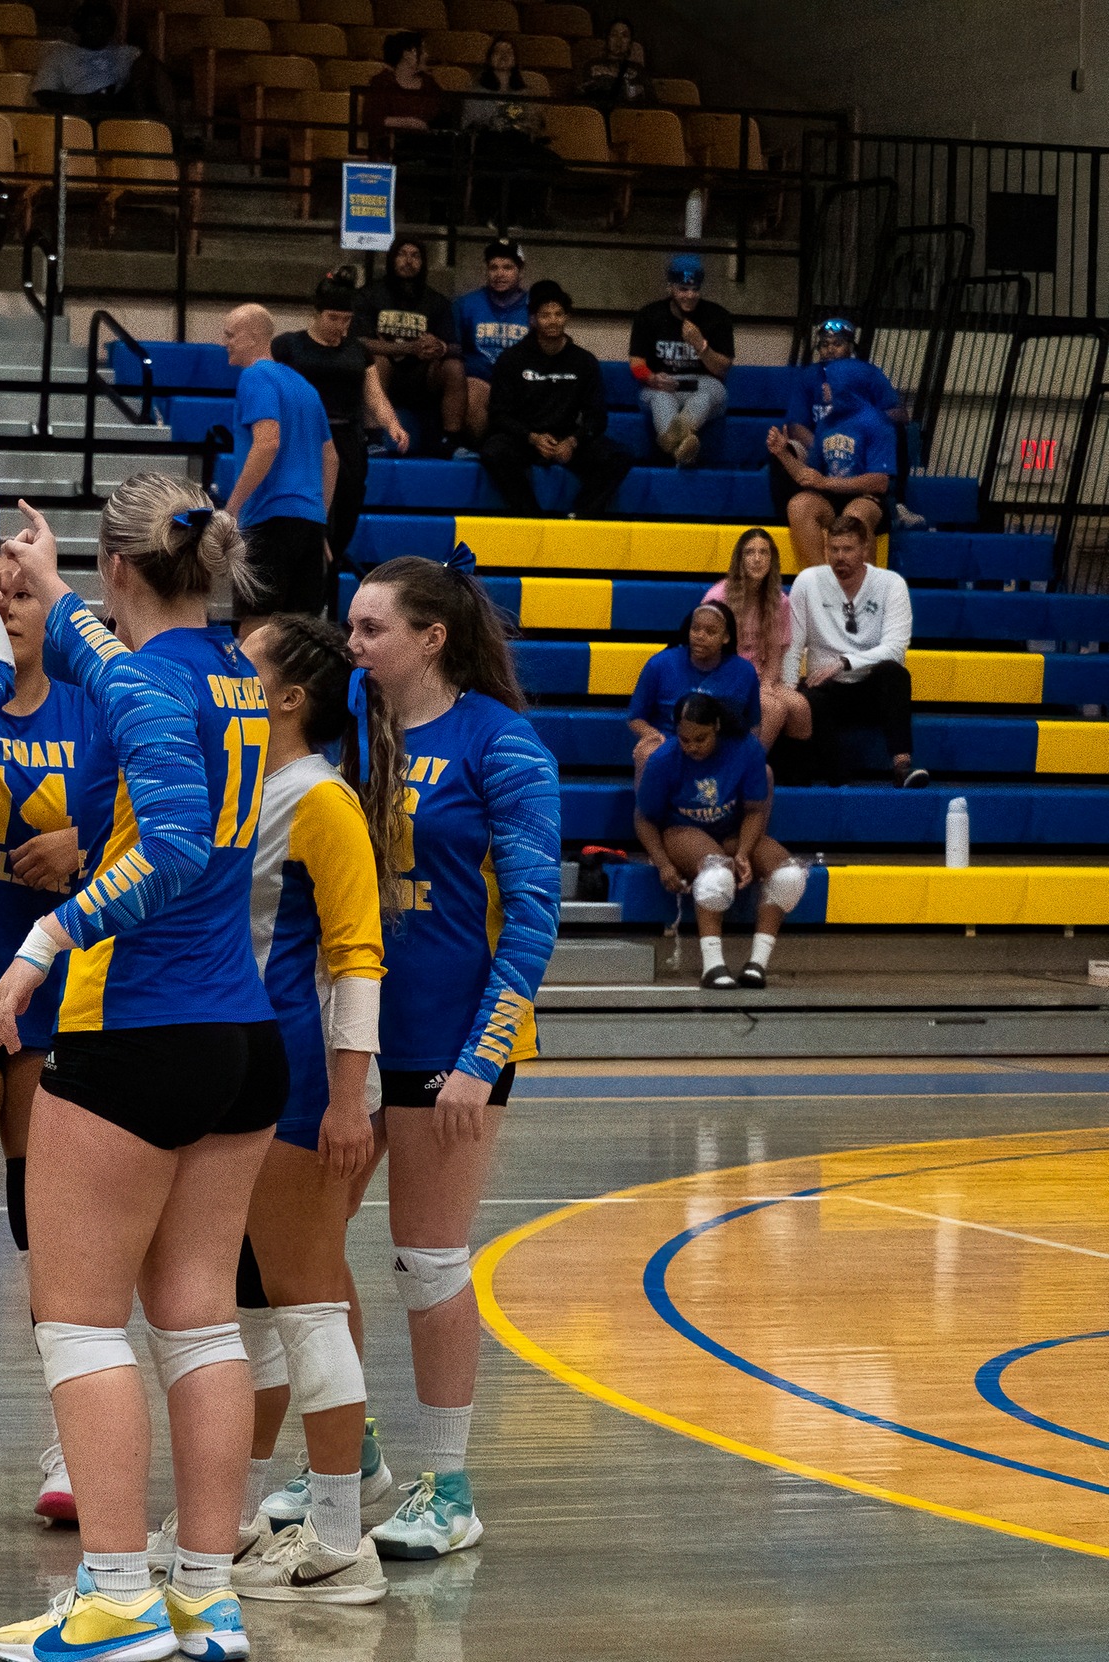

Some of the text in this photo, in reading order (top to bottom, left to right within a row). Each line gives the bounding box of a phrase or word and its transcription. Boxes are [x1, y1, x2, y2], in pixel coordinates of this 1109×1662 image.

[655, 340, 699, 360] SWEDE
[207, 674, 269, 710] SWEDE
[214, 716, 271, 849] 17
